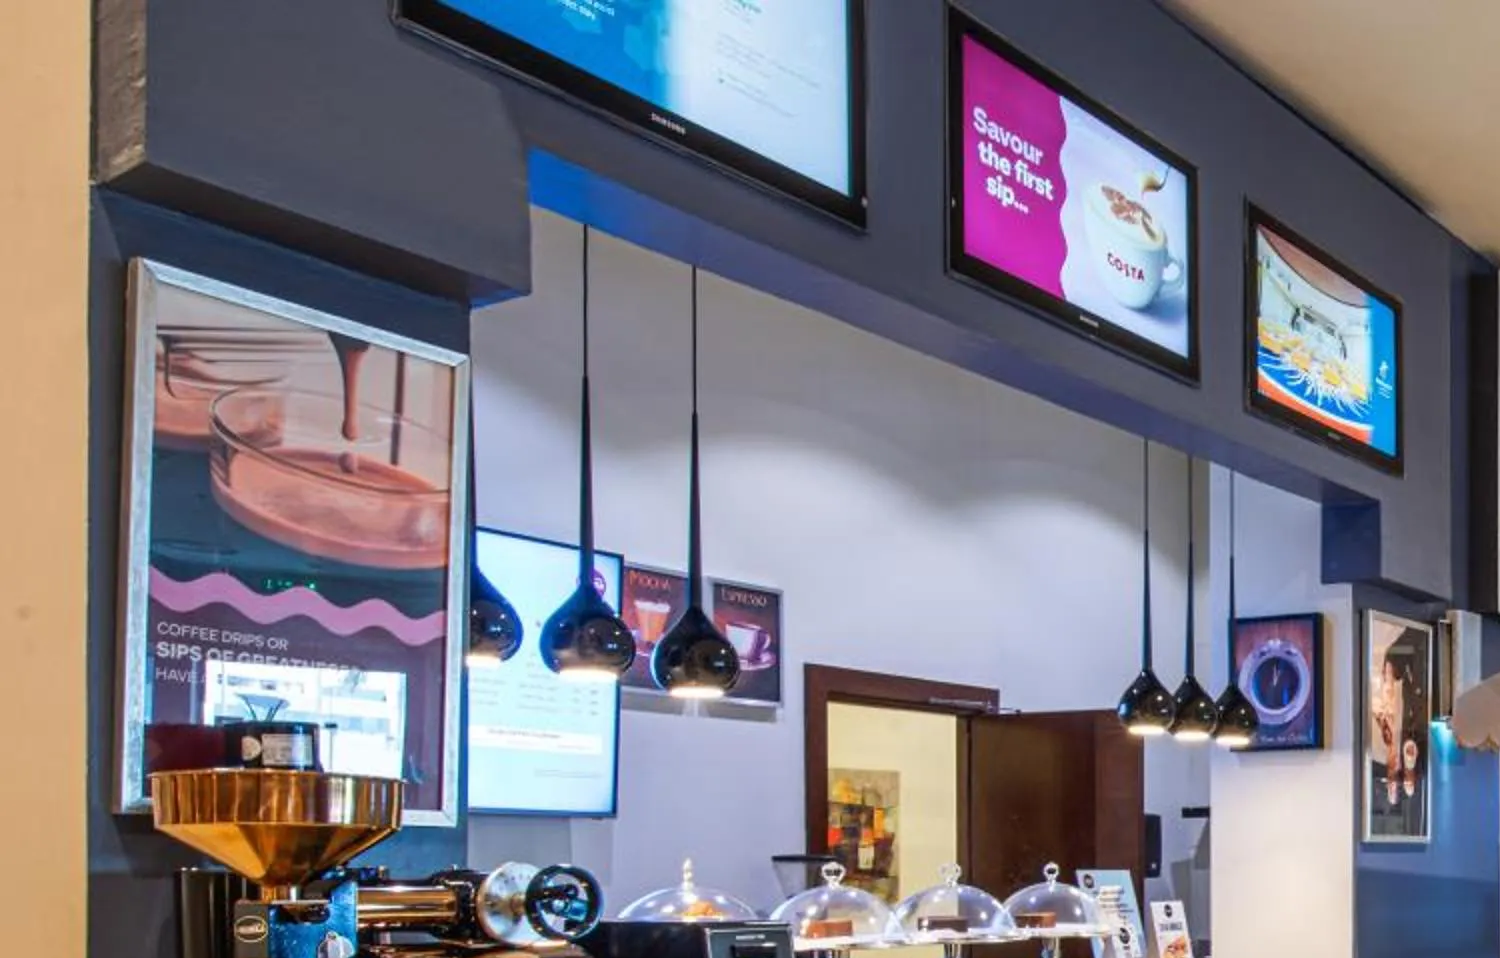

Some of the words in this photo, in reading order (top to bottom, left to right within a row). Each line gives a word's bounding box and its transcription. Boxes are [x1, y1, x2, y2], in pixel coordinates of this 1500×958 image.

[973, 106, 1043, 165] Savour
[978, 141, 1011, 176] the
[1016, 160, 1054, 201] first
[986, 175, 1029, 213] sip...
[1107, 252, 1145, 281] COSTA
[156, 621, 219, 641] COFFEE
[221, 630, 265, 648] DRIPS
[267, 637, 289, 650] OR
[156, 641, 202, 661] SIPS
[207, 648, 235, 662] OF
